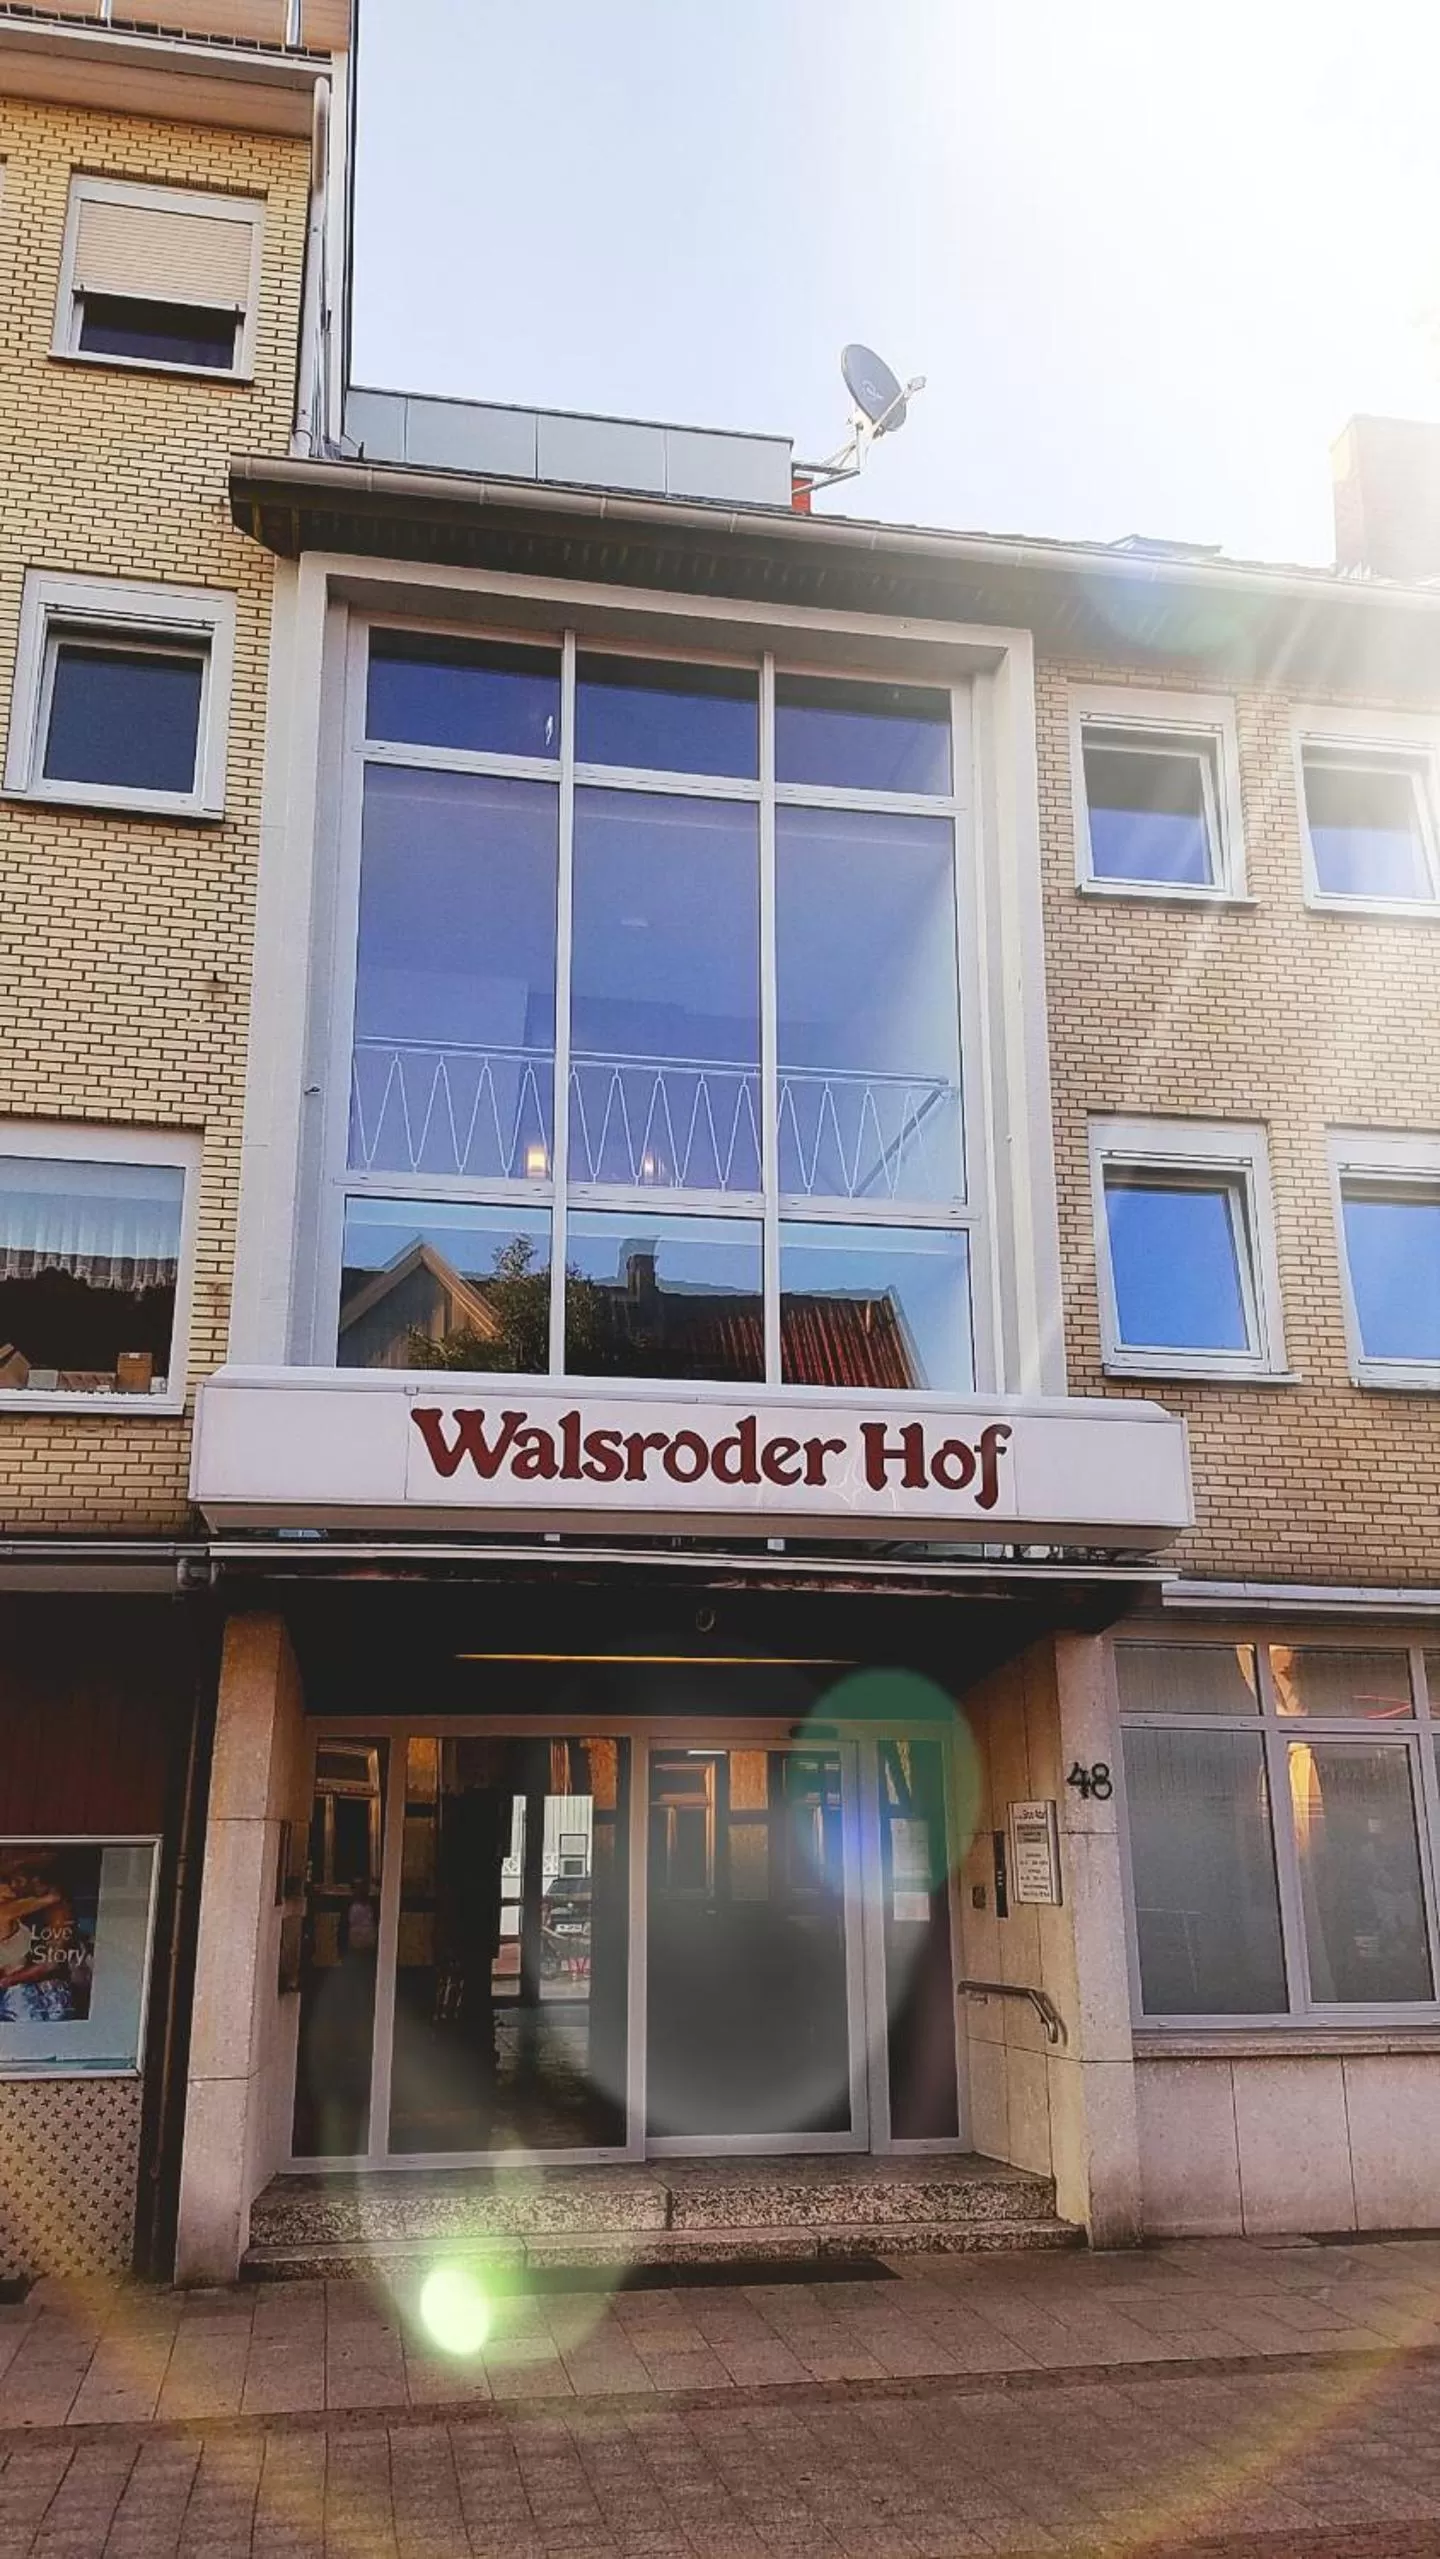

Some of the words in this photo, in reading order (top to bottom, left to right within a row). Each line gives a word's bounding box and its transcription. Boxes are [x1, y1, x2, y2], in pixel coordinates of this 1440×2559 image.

[411, 1407, 846, 1486] Walsroder
[860, 1422, 1013, 1510] Hof
[1066, 1761, 1113, 1800] 48
[31, 1924, 73, 1941] Love
[32, 1945, 86, 1967] Story
